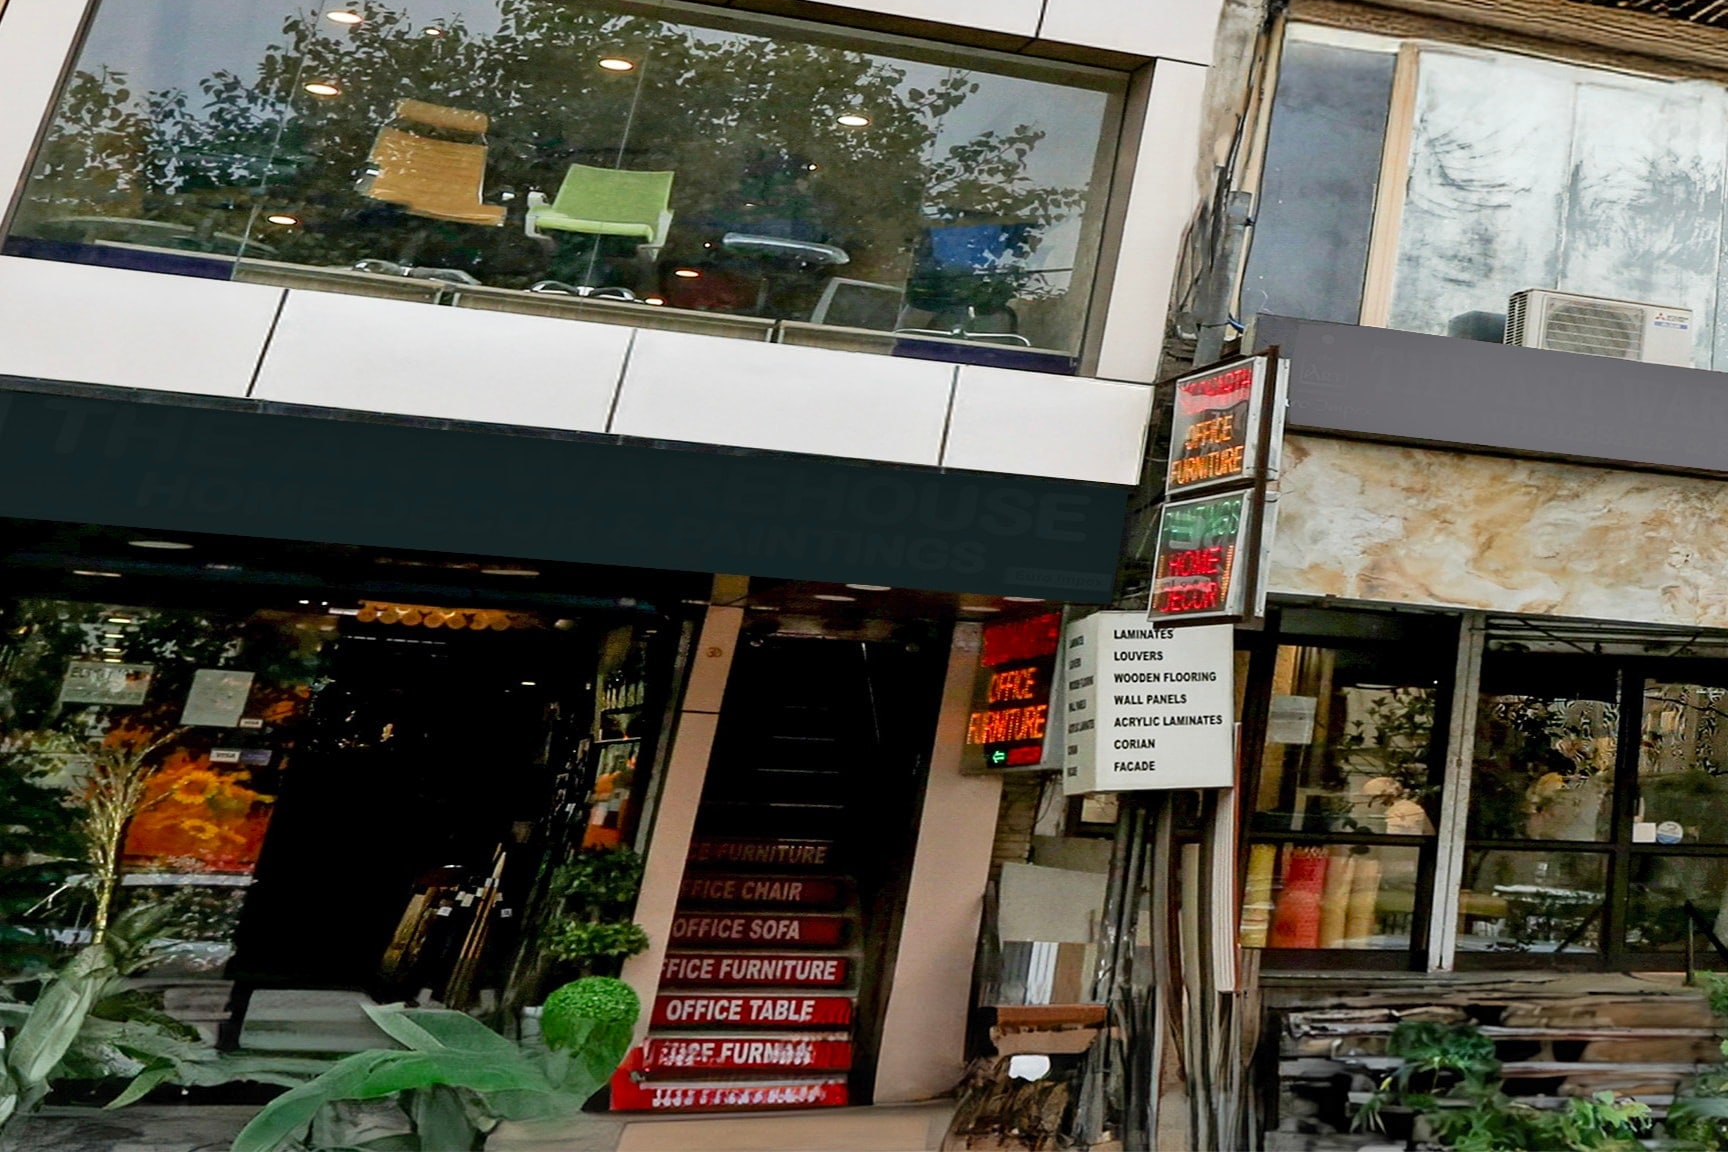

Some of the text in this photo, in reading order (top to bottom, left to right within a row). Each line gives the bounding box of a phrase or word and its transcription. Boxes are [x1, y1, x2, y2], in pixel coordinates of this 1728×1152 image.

[1185, 415, 1233, 449] OFFICE
[1171, 445, 1244, 484] FURNITURE
[1114, 629, 1174, 639] LAMINATES
[1114, 650, 1164, 661] LOUVERS
[988, 667, 1037, 703] OFFICE
[1114, 672, 1217, 683] WOODEN FLOORING
[1114, 694, 1187, 705] WALL PANELS
[967, 704, 1047, 744] FURNITURE
[1114, 715, 1223, 727] ACRYLIC LAMINATES
[1114, 739, 1156, 750] CORIAN
[1114, 760, 1156, 772] FACADE
[741, 882, 802, 901] CHAIR
[672, 918, 800, 940] OFFICE SOFA
[661, 958, 837, 980] FFICE FURNITURE
[666, 1000, 815, 1021] OFFICE TABLE
